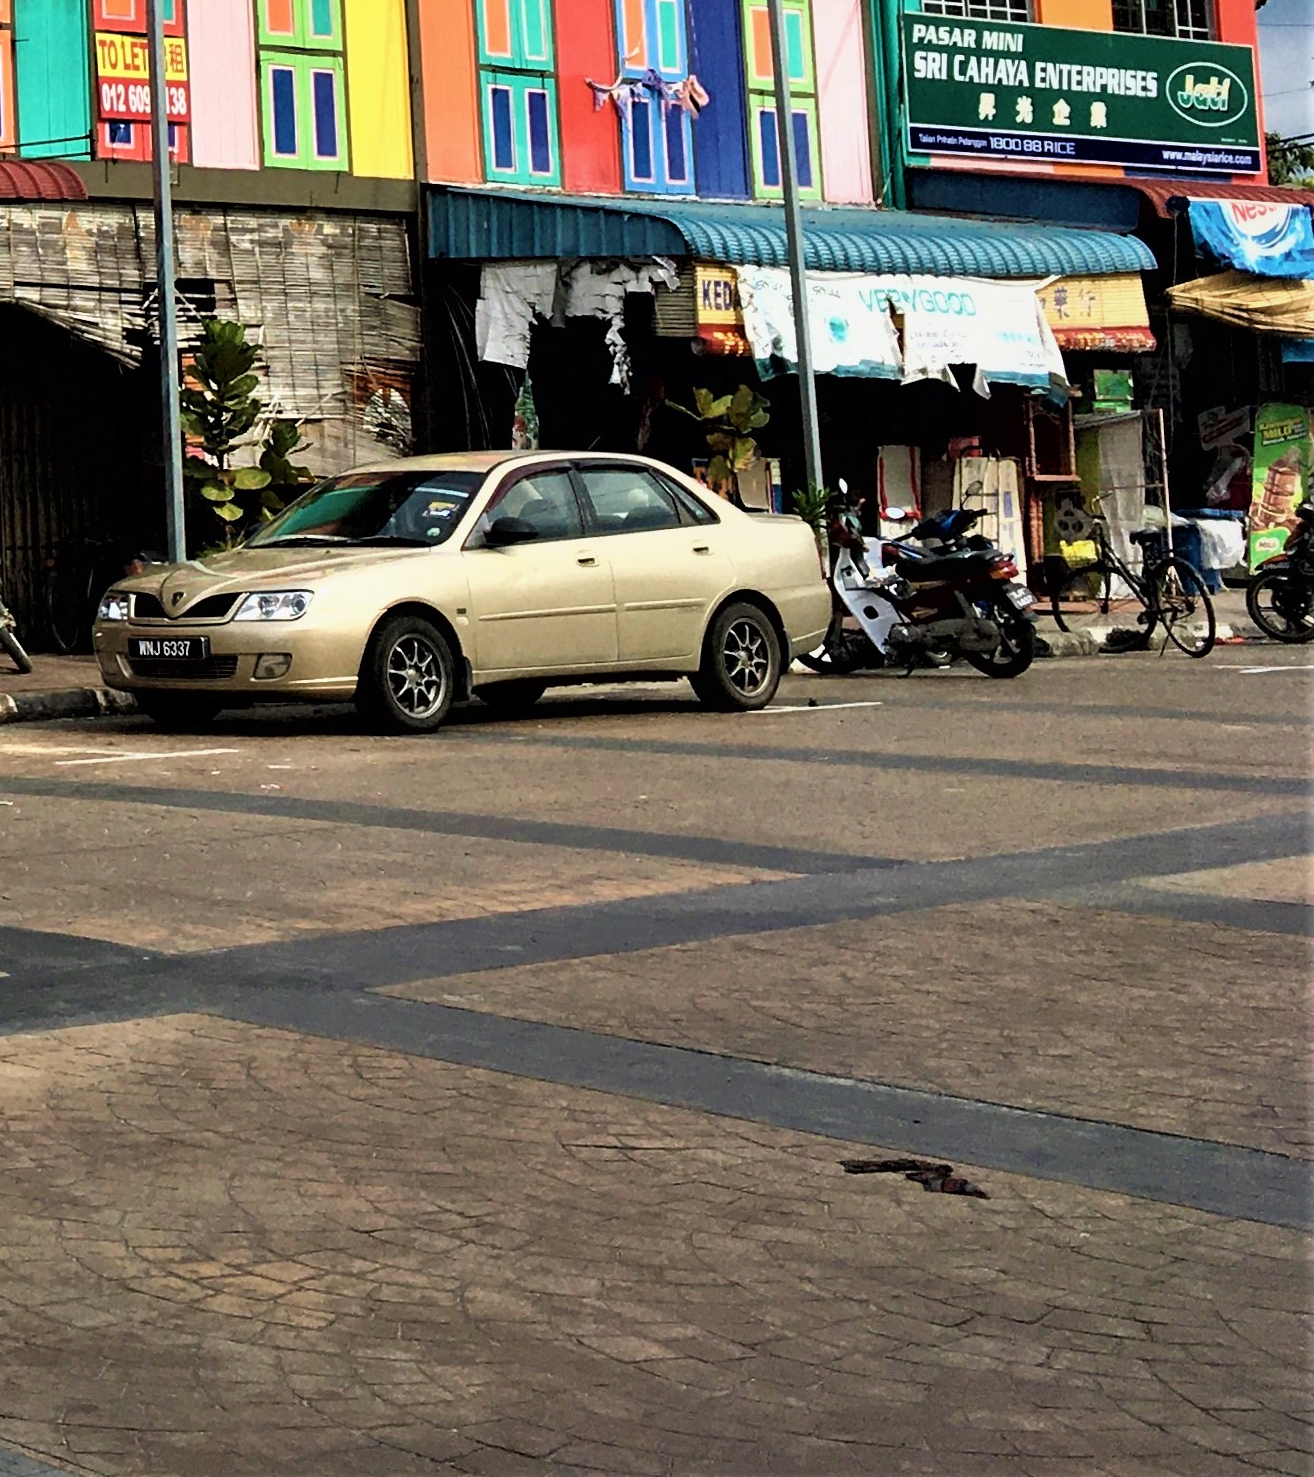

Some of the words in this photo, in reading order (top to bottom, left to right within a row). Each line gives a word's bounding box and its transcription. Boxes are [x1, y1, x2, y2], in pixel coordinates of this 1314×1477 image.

[912, 24, 977, 48] PASAR
[982, 30, 1024, 53] MINI
[98, 39, 119, 71] TO
[121, 40, 149, 72] LET
[914, 51, 948, 80] SRI
[953, 54, 1030, 87] CAHAYA
[1034, 61, 1158, 98] ENTERPRISES
[101, 82, 127, 113] 012
[128, 84, 188, 116] 609138
[989, 136, 1022, 151] 1800
[1023, 138, 1042, 152] 88
[1044, 140, 1076, 155] RICE
[701, 279, 733, 311] KED
[138, 640, 161, 656] WNJ
[162, 641, 191, 657] 6337
